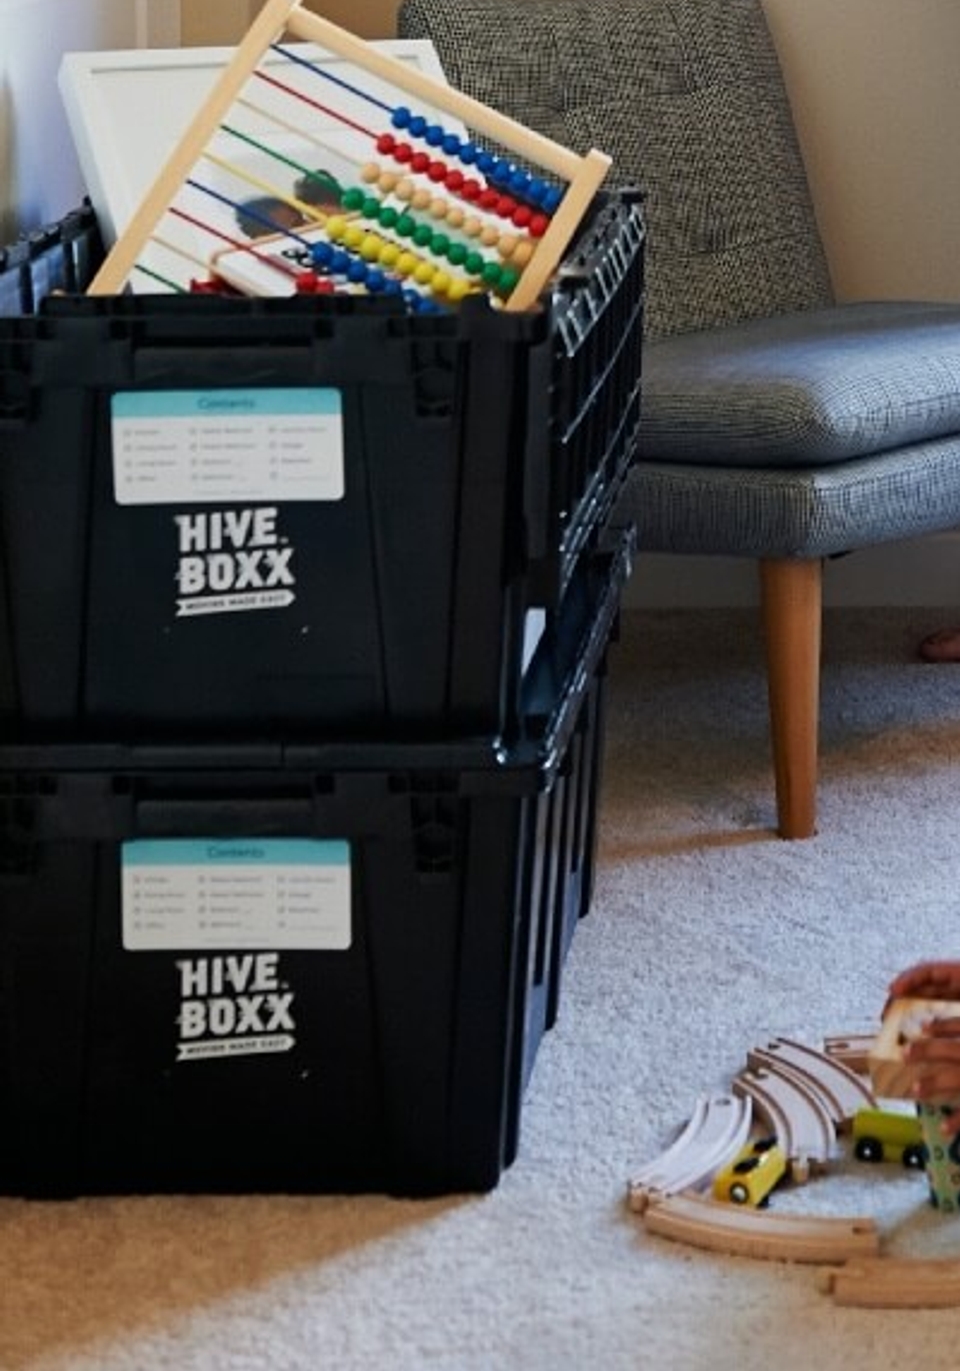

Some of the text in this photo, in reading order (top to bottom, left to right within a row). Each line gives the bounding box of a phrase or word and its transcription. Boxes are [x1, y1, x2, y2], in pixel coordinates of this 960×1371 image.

[175, 548, 296, 595] BOXX
[207, 846, 265, 859] Contents
[175, 993, 296, 1039] BOXX
